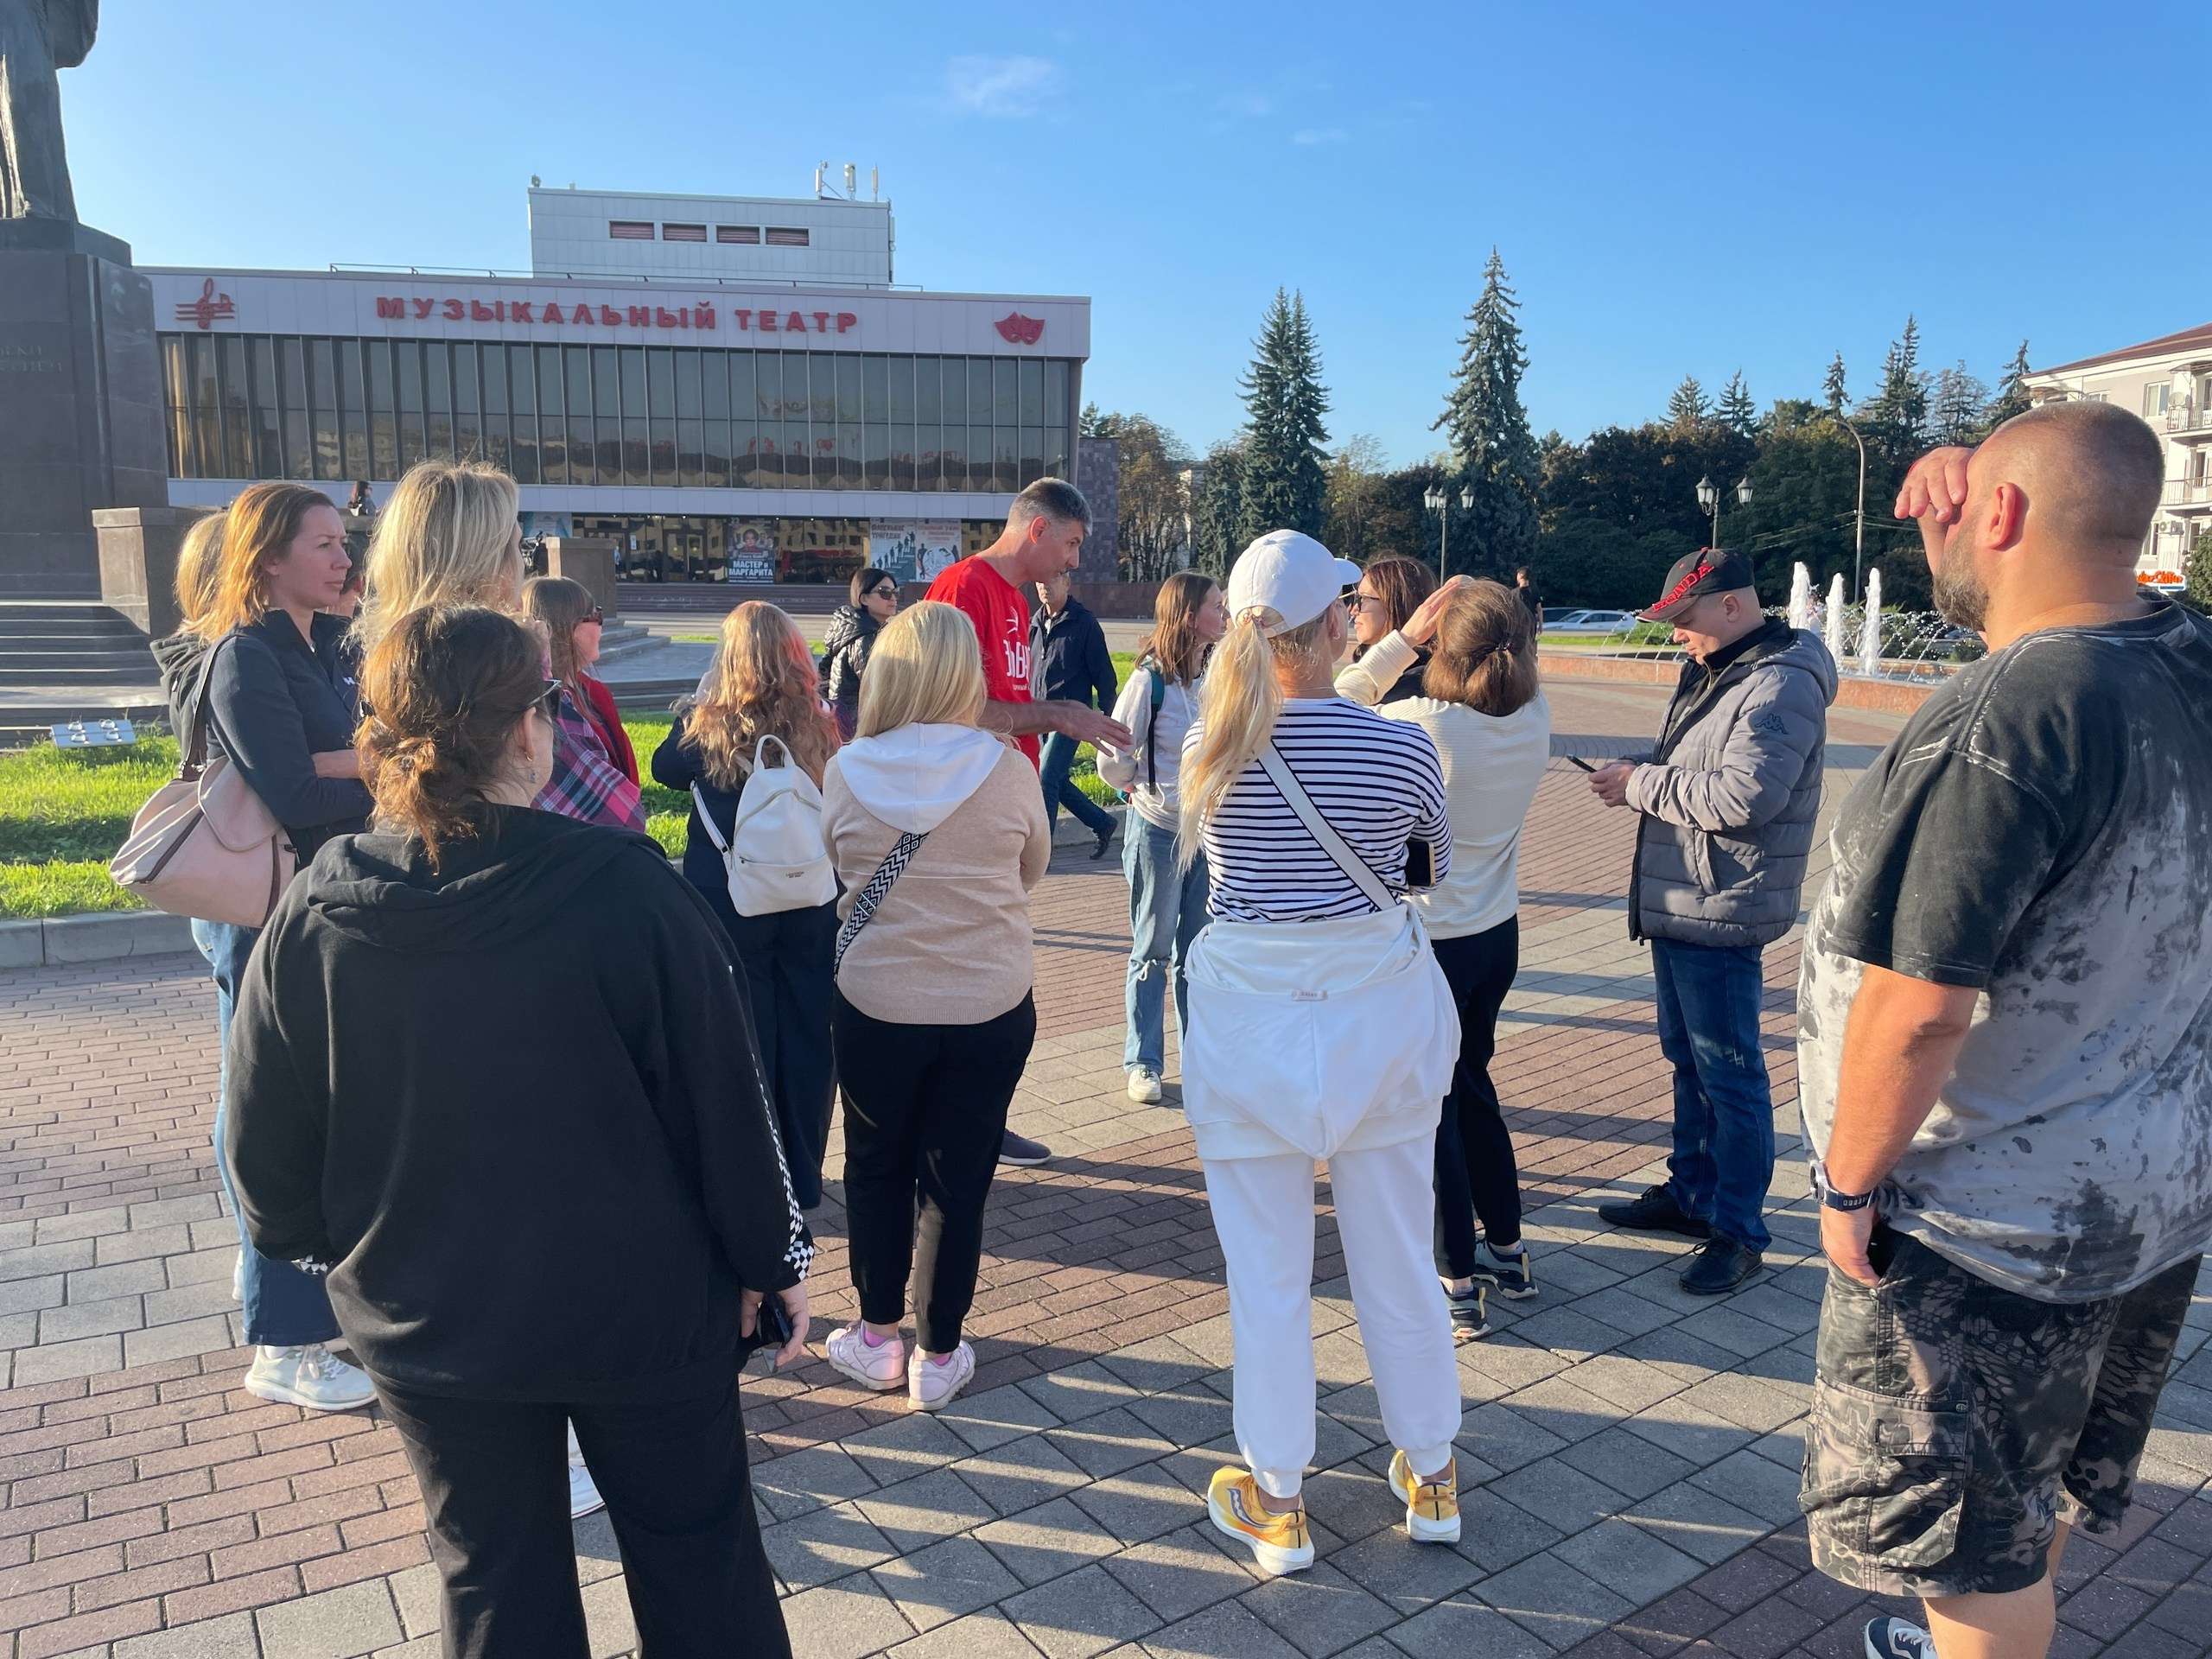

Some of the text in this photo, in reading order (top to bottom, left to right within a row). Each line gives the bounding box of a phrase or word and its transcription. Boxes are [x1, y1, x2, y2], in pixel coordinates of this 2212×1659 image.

[376, 296, 857, 334] МУЗЫКАЛЬНЫЙ ТЕАТР
[728, 568, 773, 576] МАРГАРИТА
[1652, 564, 1714, 612] HONDA
